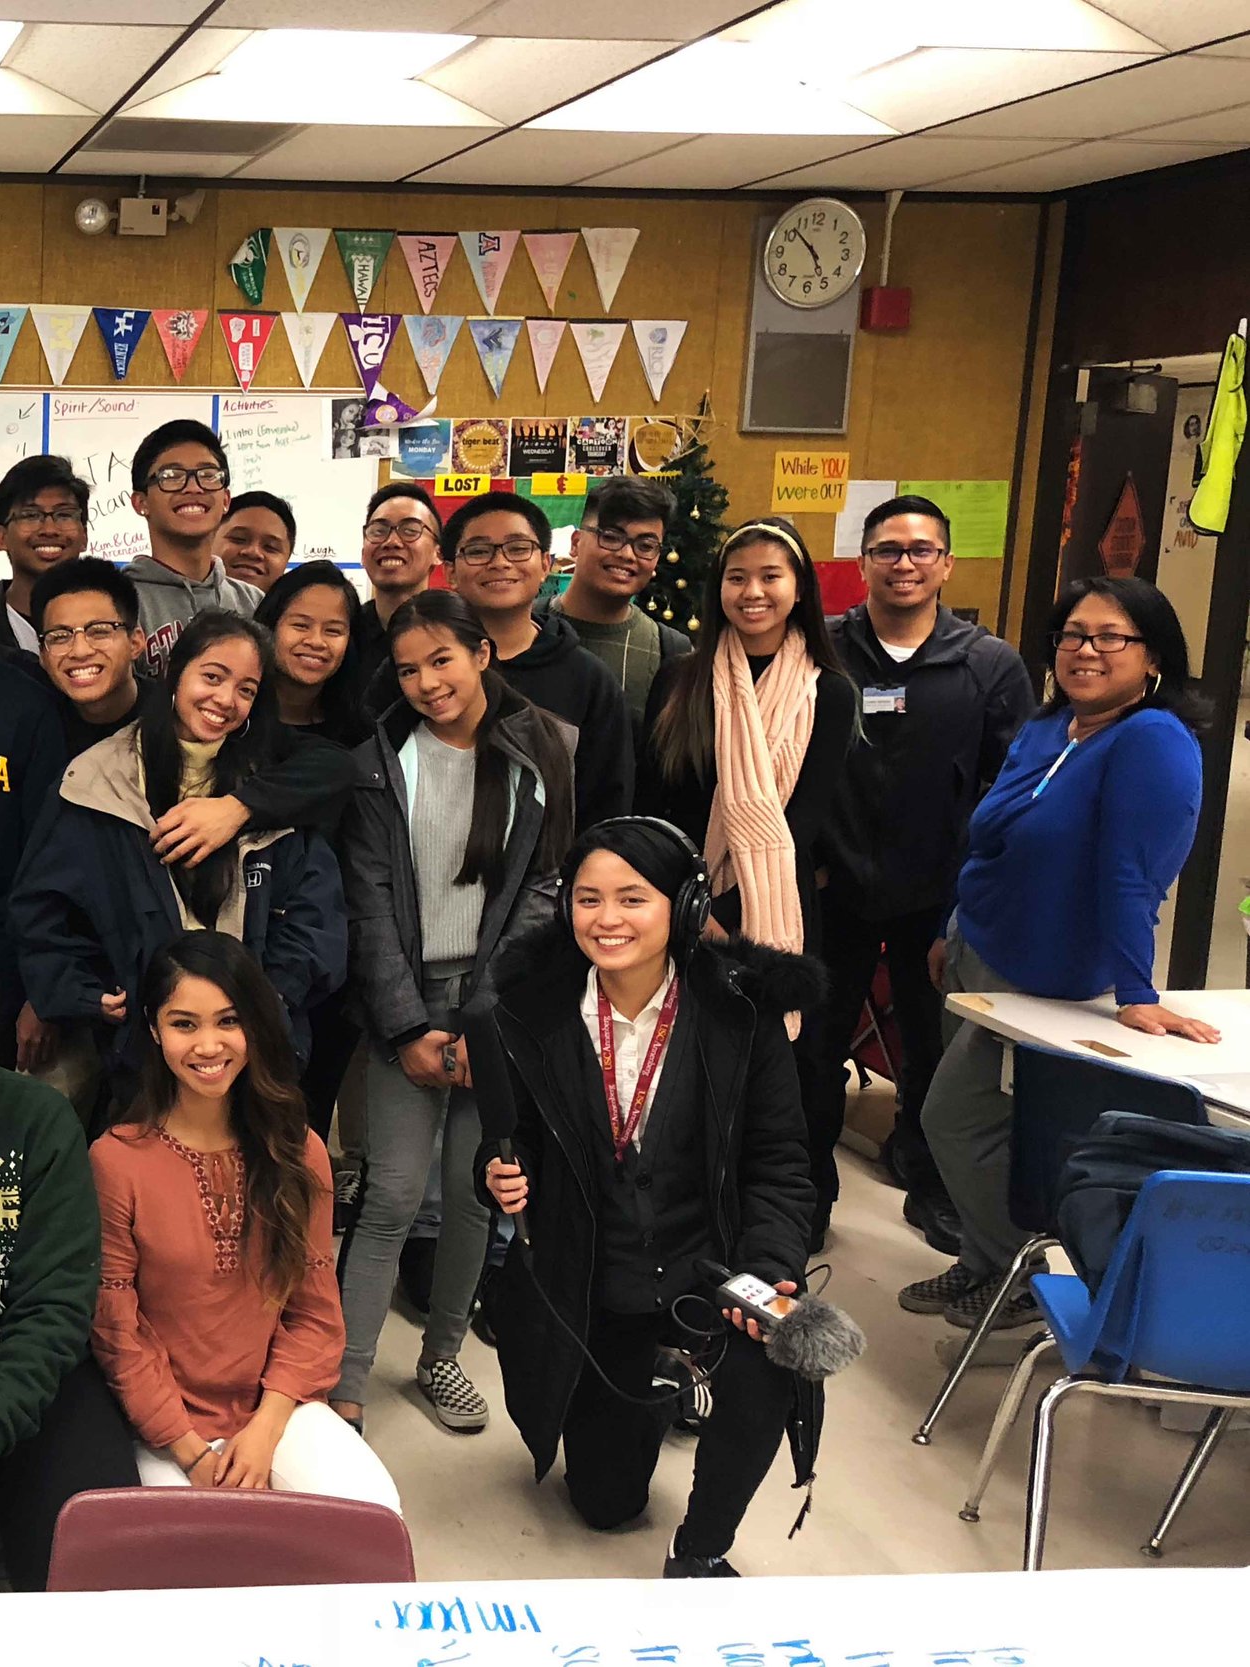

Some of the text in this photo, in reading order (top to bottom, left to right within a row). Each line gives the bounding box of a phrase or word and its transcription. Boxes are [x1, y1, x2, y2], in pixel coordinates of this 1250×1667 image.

[798, 217, 808, 230] 11
[812, 212, 826, 226] 12
[833, 219, 838, 231] 1
[784, 229, 797, 242] 10
[839, 231, 849, 244] 2
[775, 245, 784, 258] 9
[841, 248, 850, 261] 3
[418, 240, 439, 298] AZTECS
[778, 263, 787, 276] 8
[832, 265, 842, 277] 4
[789, 275, 797, 287] 7
[803, 281, 812, 294] 6
[820, 276, 829, 289] 5
[361, 316, 390, 366] TCU
[113, 343, 129, 376] KENTUCKY
[462, 437, 500, 448] tiger beat
[408, 446, 436, 454] MONDAY
[781, 458, 846, 477] While YOU
[444, 477, 481, 492] LOST
[777, 483, 845, 500] were OUT
[113, 533, 123, 546] &
[303, 544, 336, 558] Laugh
[602, 1015, 613, 1070] USC Annenberg
[641, 1023, 669, 1077] USC Annenberg
[634, 1090, 646, 1110] USC
